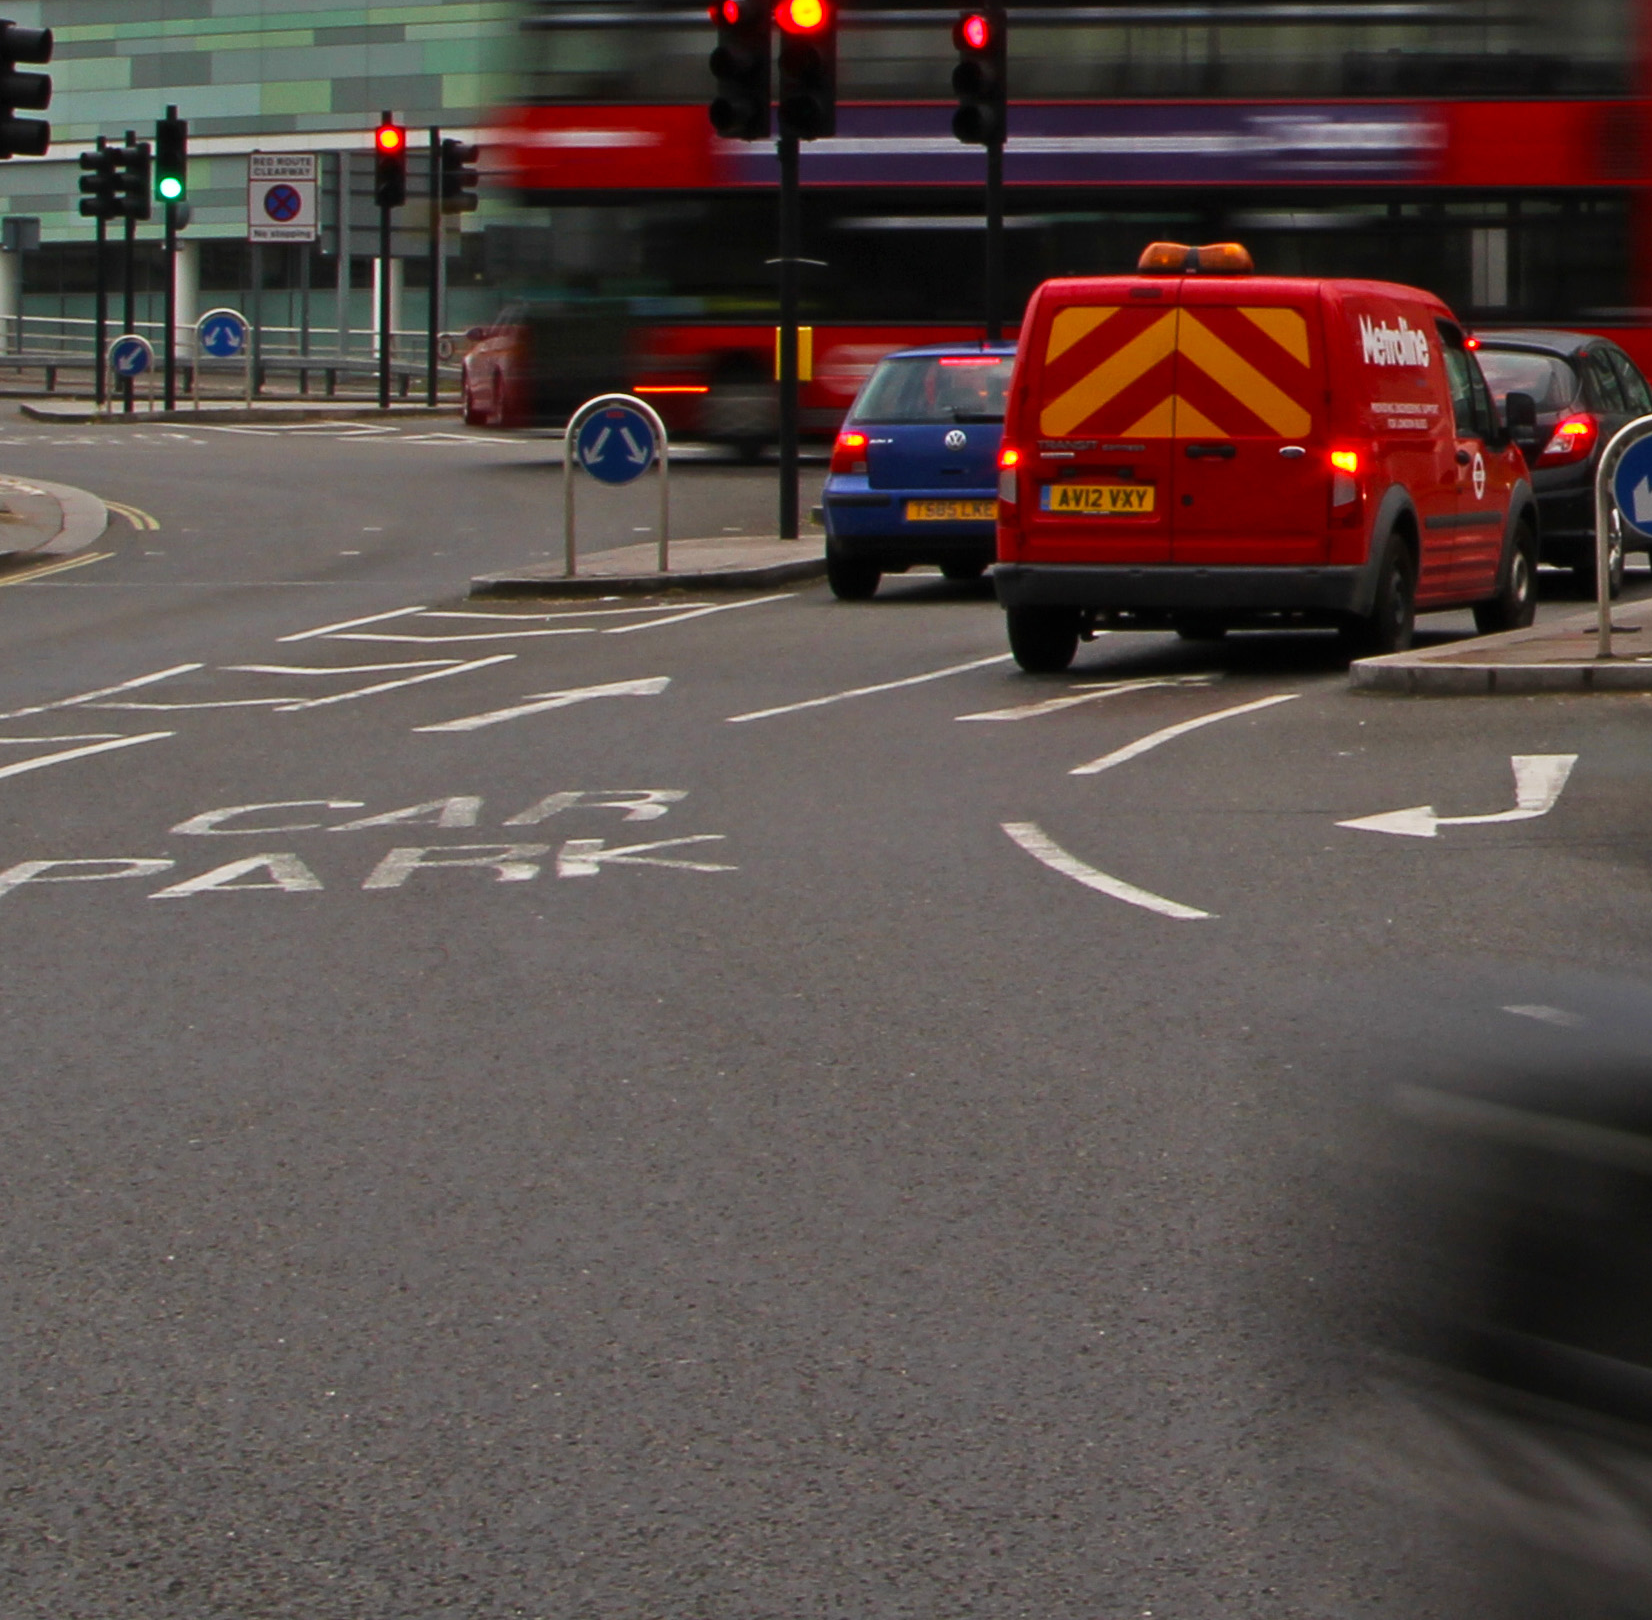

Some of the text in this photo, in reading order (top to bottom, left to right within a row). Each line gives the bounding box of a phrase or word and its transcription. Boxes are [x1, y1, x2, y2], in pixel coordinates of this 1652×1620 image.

[253, 157, 312, 166] RED ROUTE
[254, 167, 309, 175] CLEARWAY
[1359, 314, 1430, 367] Metroline
[1037, 440, 1098, 451] TRANSIT
[1058, 488, 1148, 508] AV12 VXY
[168, 789, 690, 835] CAR
[0, 834, 739, 900] PARK
